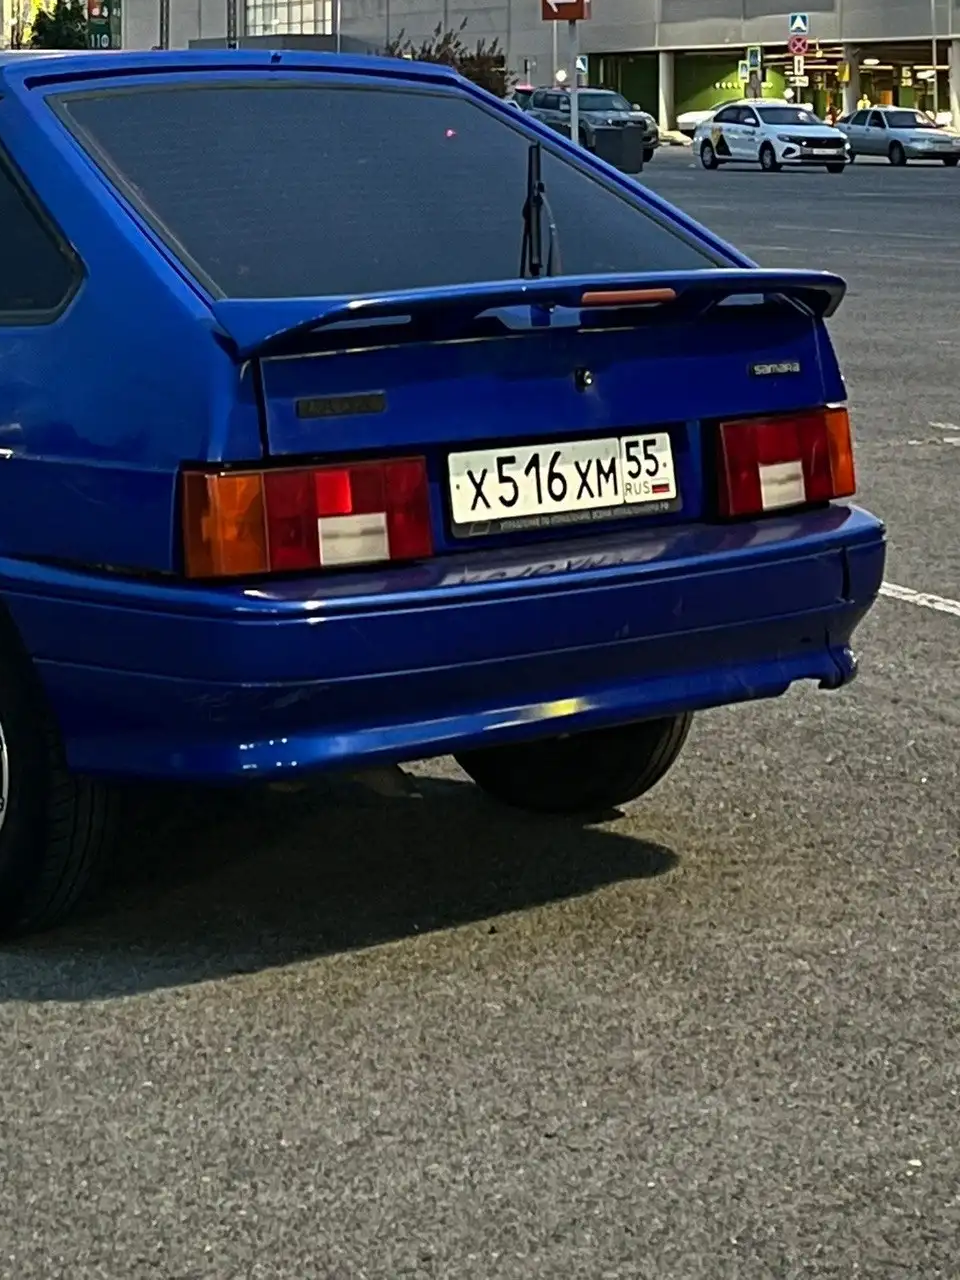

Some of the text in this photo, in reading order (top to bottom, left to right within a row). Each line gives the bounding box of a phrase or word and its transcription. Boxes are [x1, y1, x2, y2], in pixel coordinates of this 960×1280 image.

[467, 439, 660, 511] Х516ХМ 55
[625, 480, 651, 496] RUS
